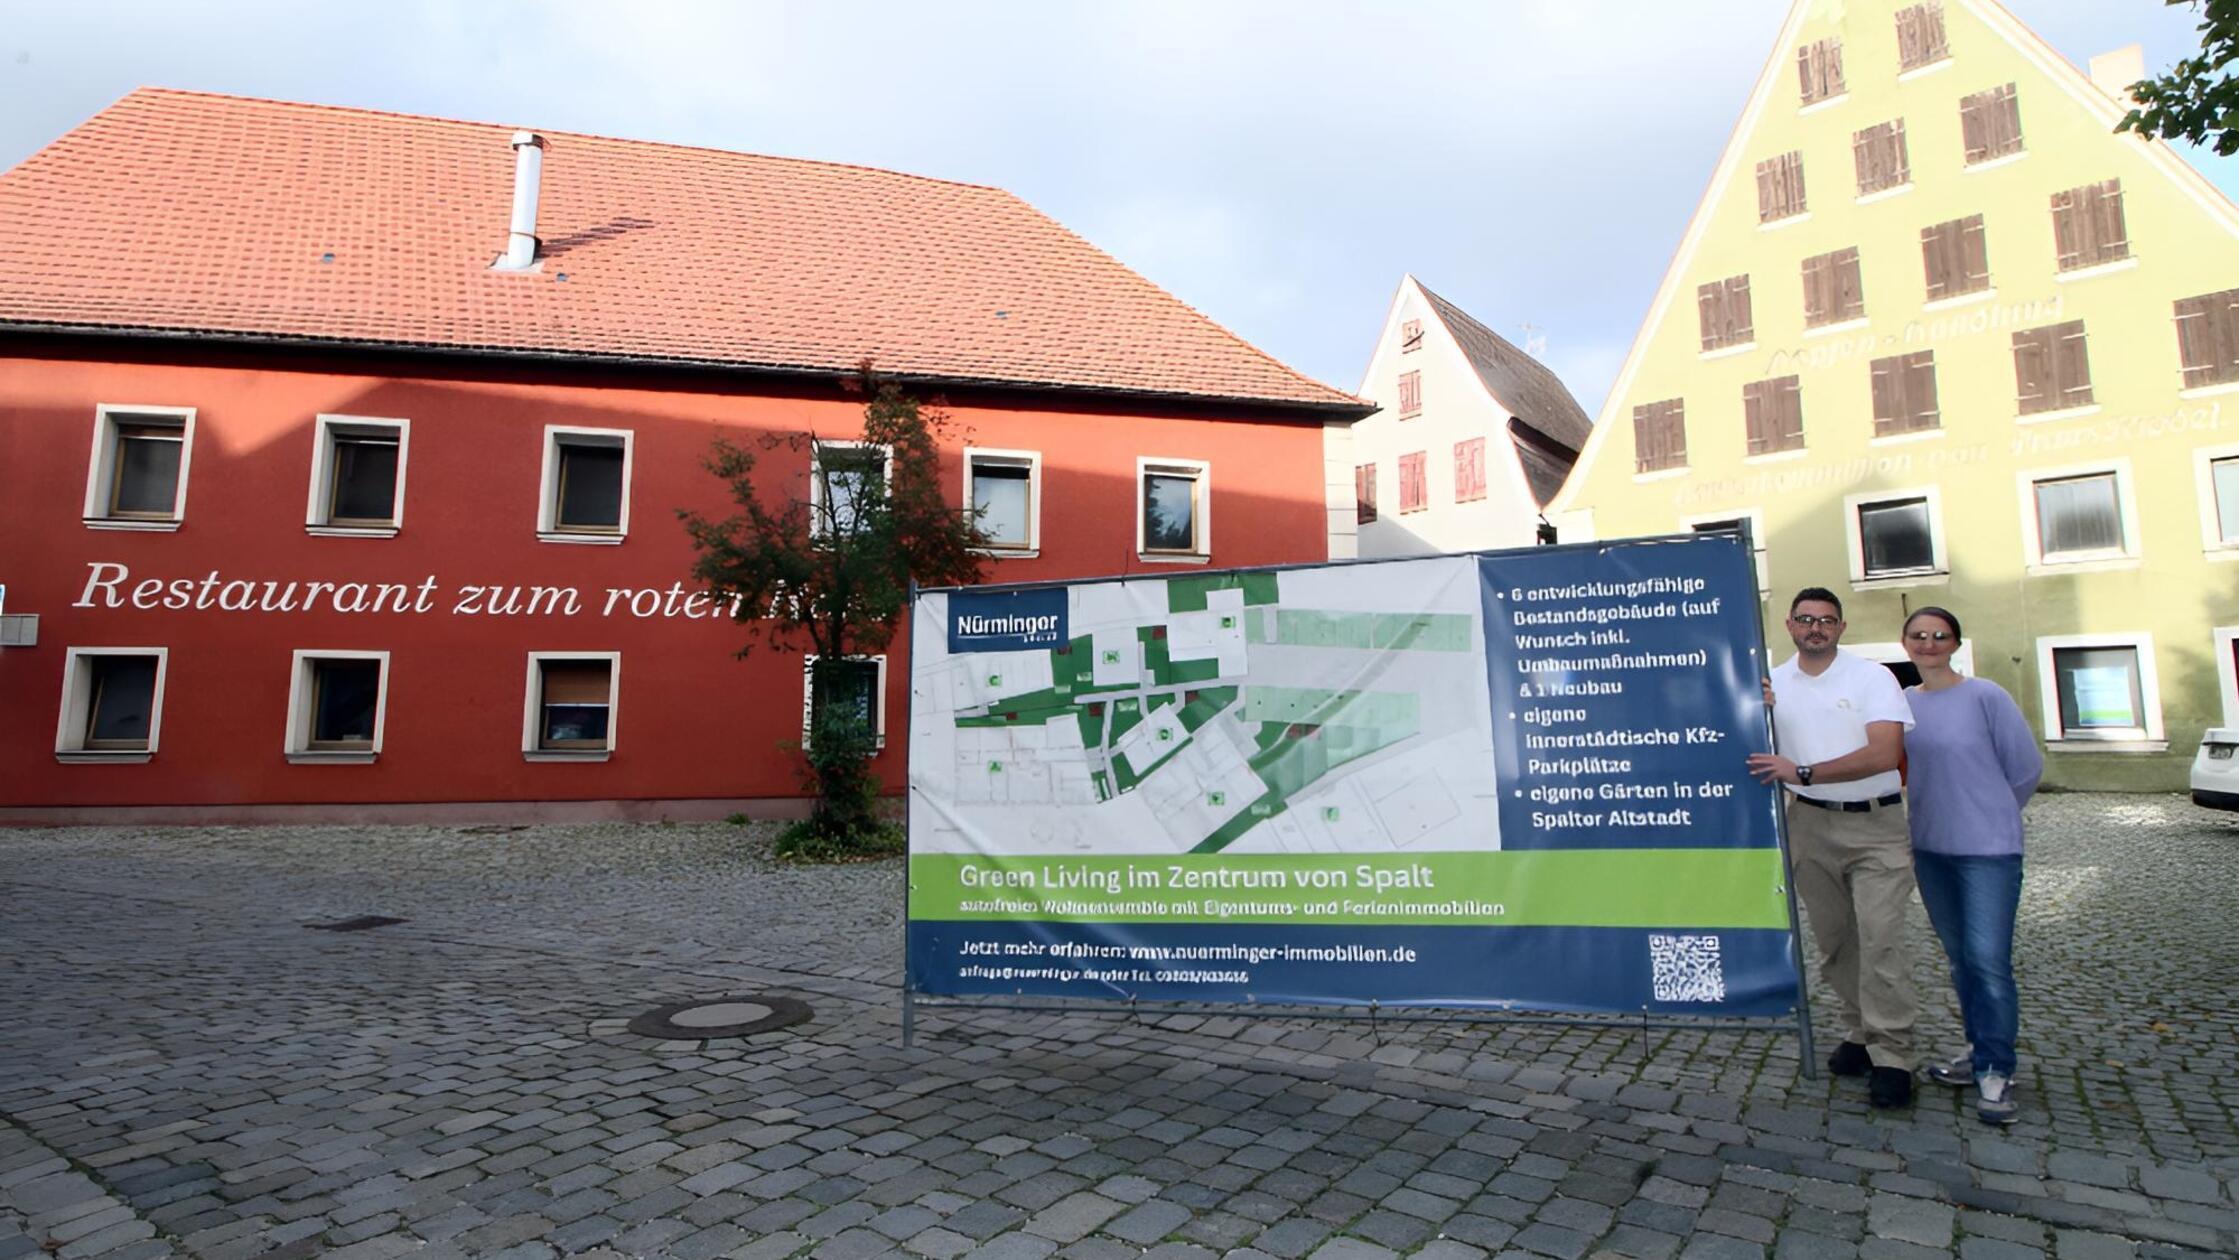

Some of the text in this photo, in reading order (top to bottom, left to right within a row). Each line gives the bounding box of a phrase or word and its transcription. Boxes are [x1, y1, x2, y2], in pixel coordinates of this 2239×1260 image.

[72, 562, 438, 613] Restaurant
[453, 584, 582, 615] zum
[602, 581, 743, 619] roten
[1511, 577, 1705, 602] 6 entwicklungsfähige
[1514, 597, 1720, 626] Bestandsgebäude (auf
[957, 614, 1058, 635] Nürminger
[1591, 628, 1631, 645] inkl.
[1518, 648, 1707, 673] Umbaumaßnahmen)
[1519, 685, 1532, 697] &
[1551, 680, 1623, 697] Neubau
[1524, 707, 1586, 726] eigene
[1686, 727, 1725, 743] Kfz-
[1529, 756, 1632, 777] Parkplätze
[1530, 781, 1733, 804] eigene Gärten in der
[1532, 808, 1692, 830] Spalter Altstadt
[960, 864, 1434, 893] Green Living im Zentrum von Spalt
[1172, 901, 1199, 915] mit
[1204, 899, 1297, 917] Eigentums-
[1303, 901, 1338, 916] und
[1343, 900, 1506, 917] Ferienimmobilien
[959, 940, 1417, 965] Jetzt mehr erfahren: www.nuerminger-immobilien.de
